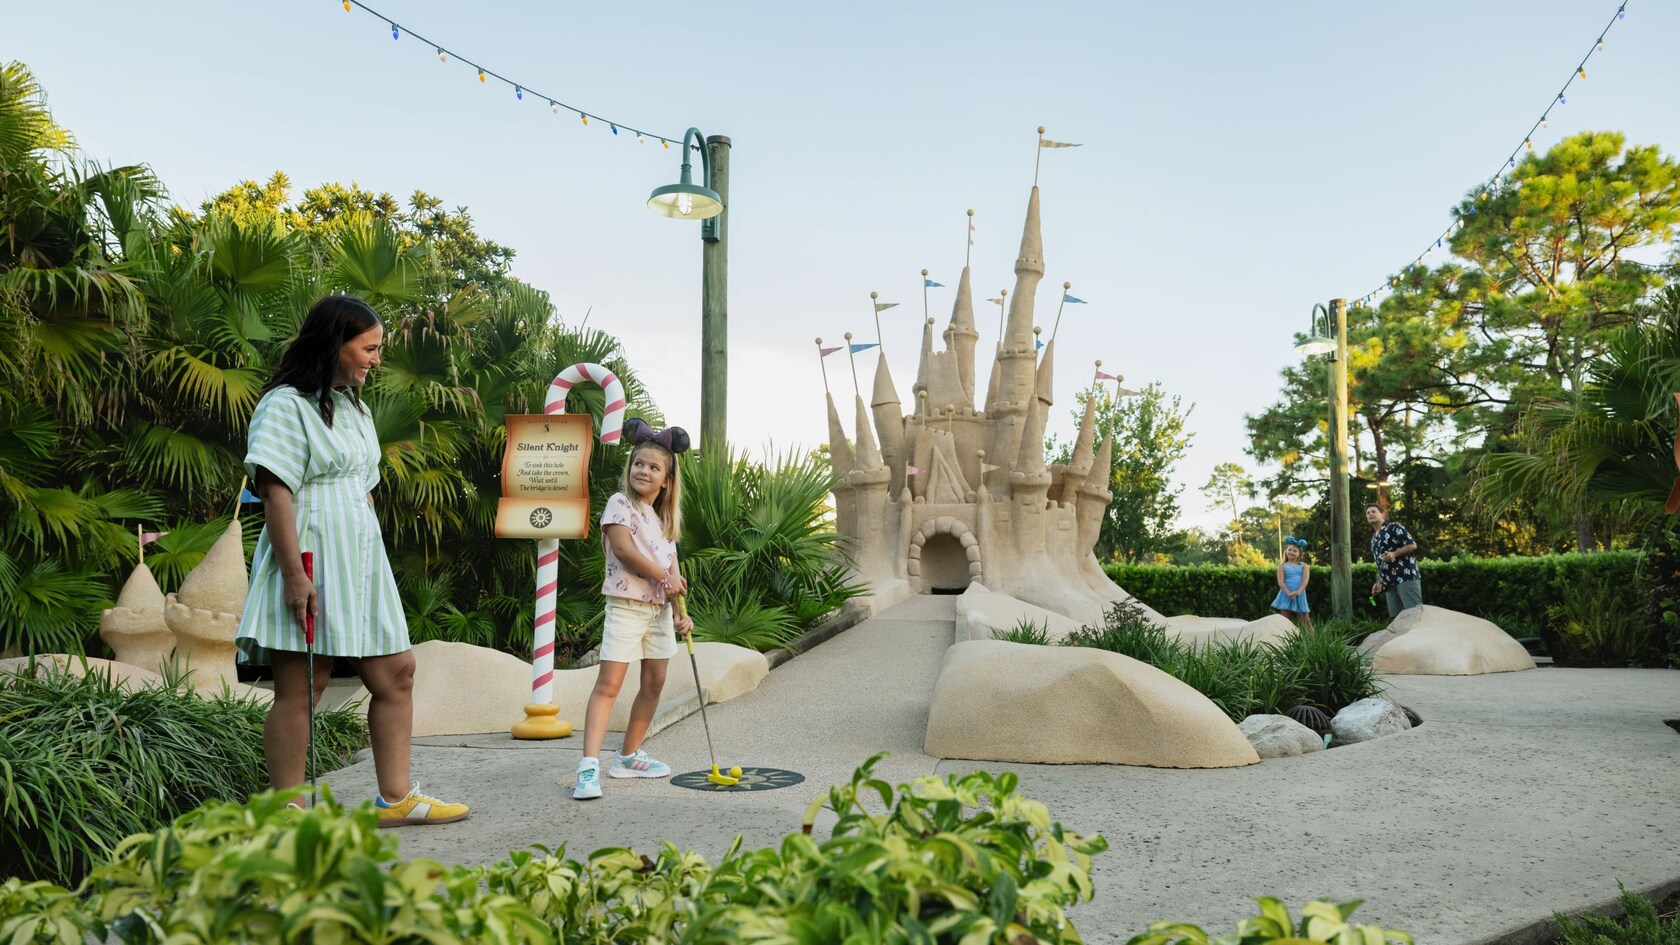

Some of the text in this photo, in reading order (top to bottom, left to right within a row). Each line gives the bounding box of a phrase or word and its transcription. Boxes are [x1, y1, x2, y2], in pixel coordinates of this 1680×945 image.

[517, 442, 579, 453] Silent Knight
[516, 469, 531, 477] And
[530, 485, 547, 493] bridge
